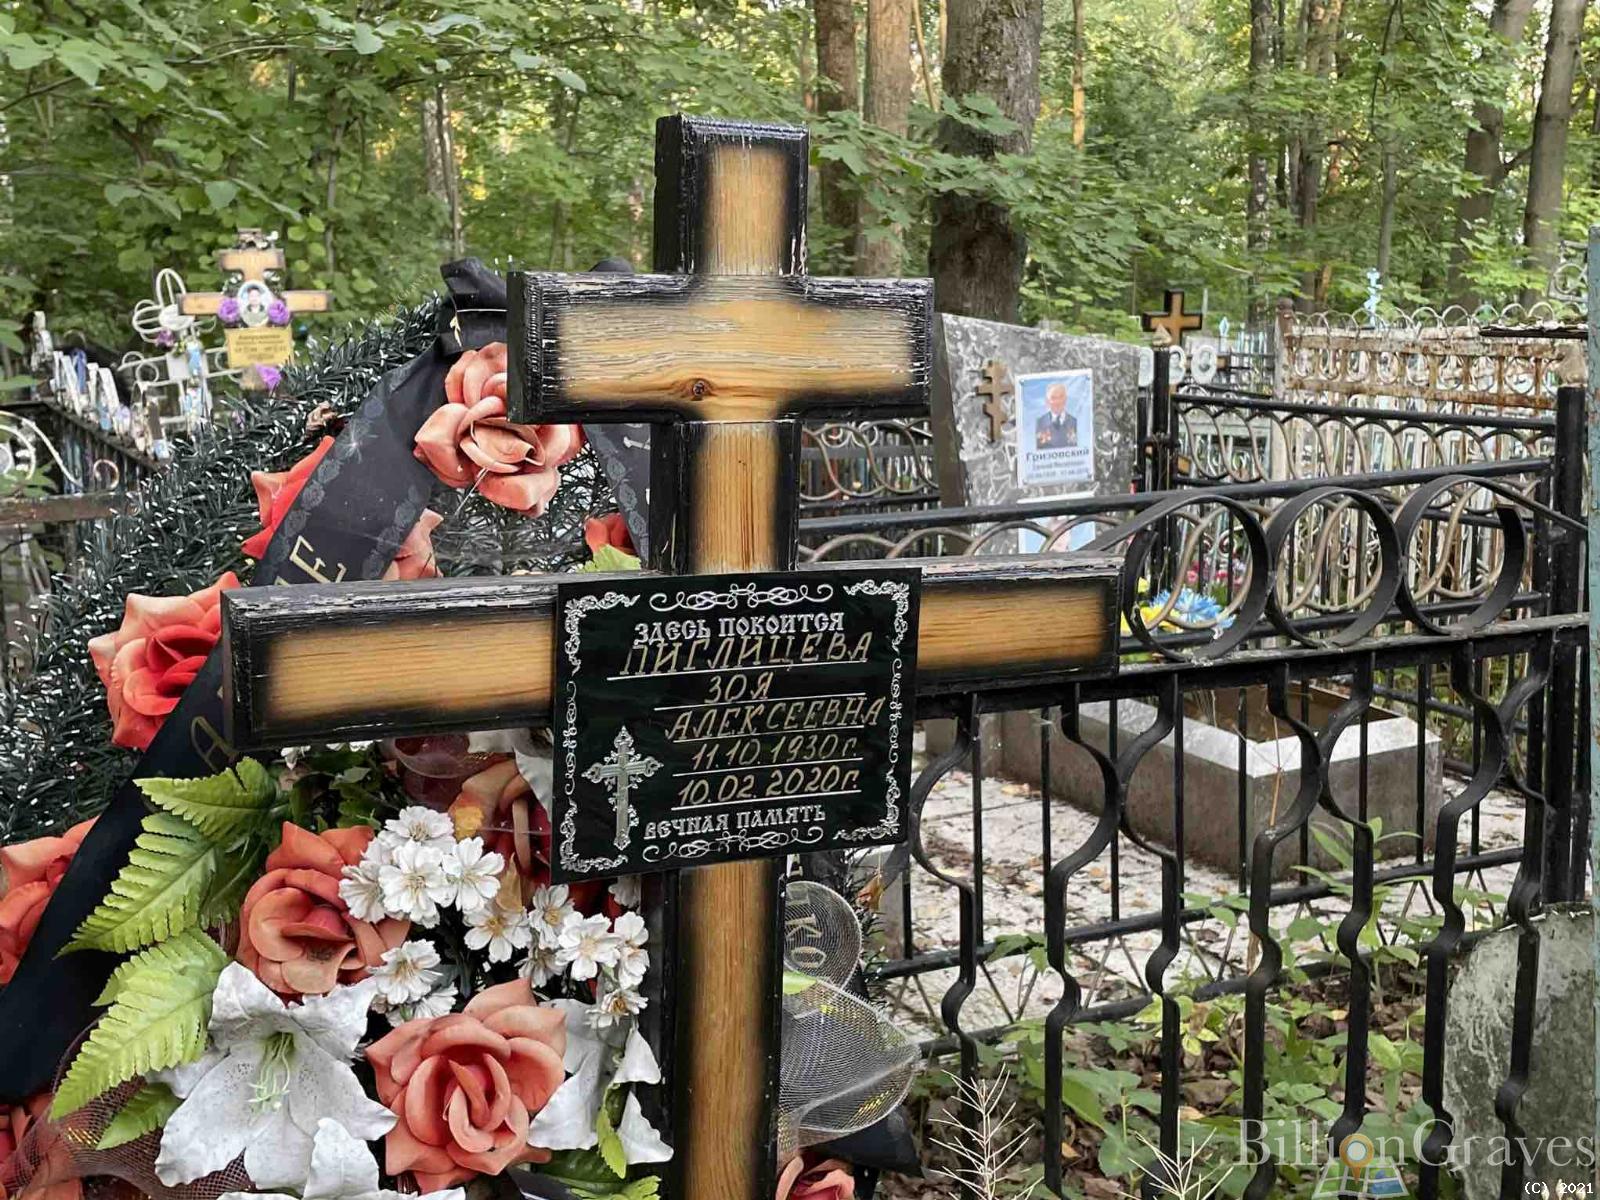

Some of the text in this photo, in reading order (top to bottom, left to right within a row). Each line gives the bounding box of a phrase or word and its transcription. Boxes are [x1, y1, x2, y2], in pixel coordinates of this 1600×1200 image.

[1026, 447, 1090, 462] Гризовский
[633, 612, 844, 646] ЗДЕСЬ ПОКОИТСЯ
[619, 631, 873, 675] ПИГЛИЦЕВА
[704, 671, 774, 704] ЗОЯ
[665, 697, 886, 740] АЛЕКСЕЕВНА
[644, 804, 826, 840] ВЕЧНАЯ ПАМЯТЬ
